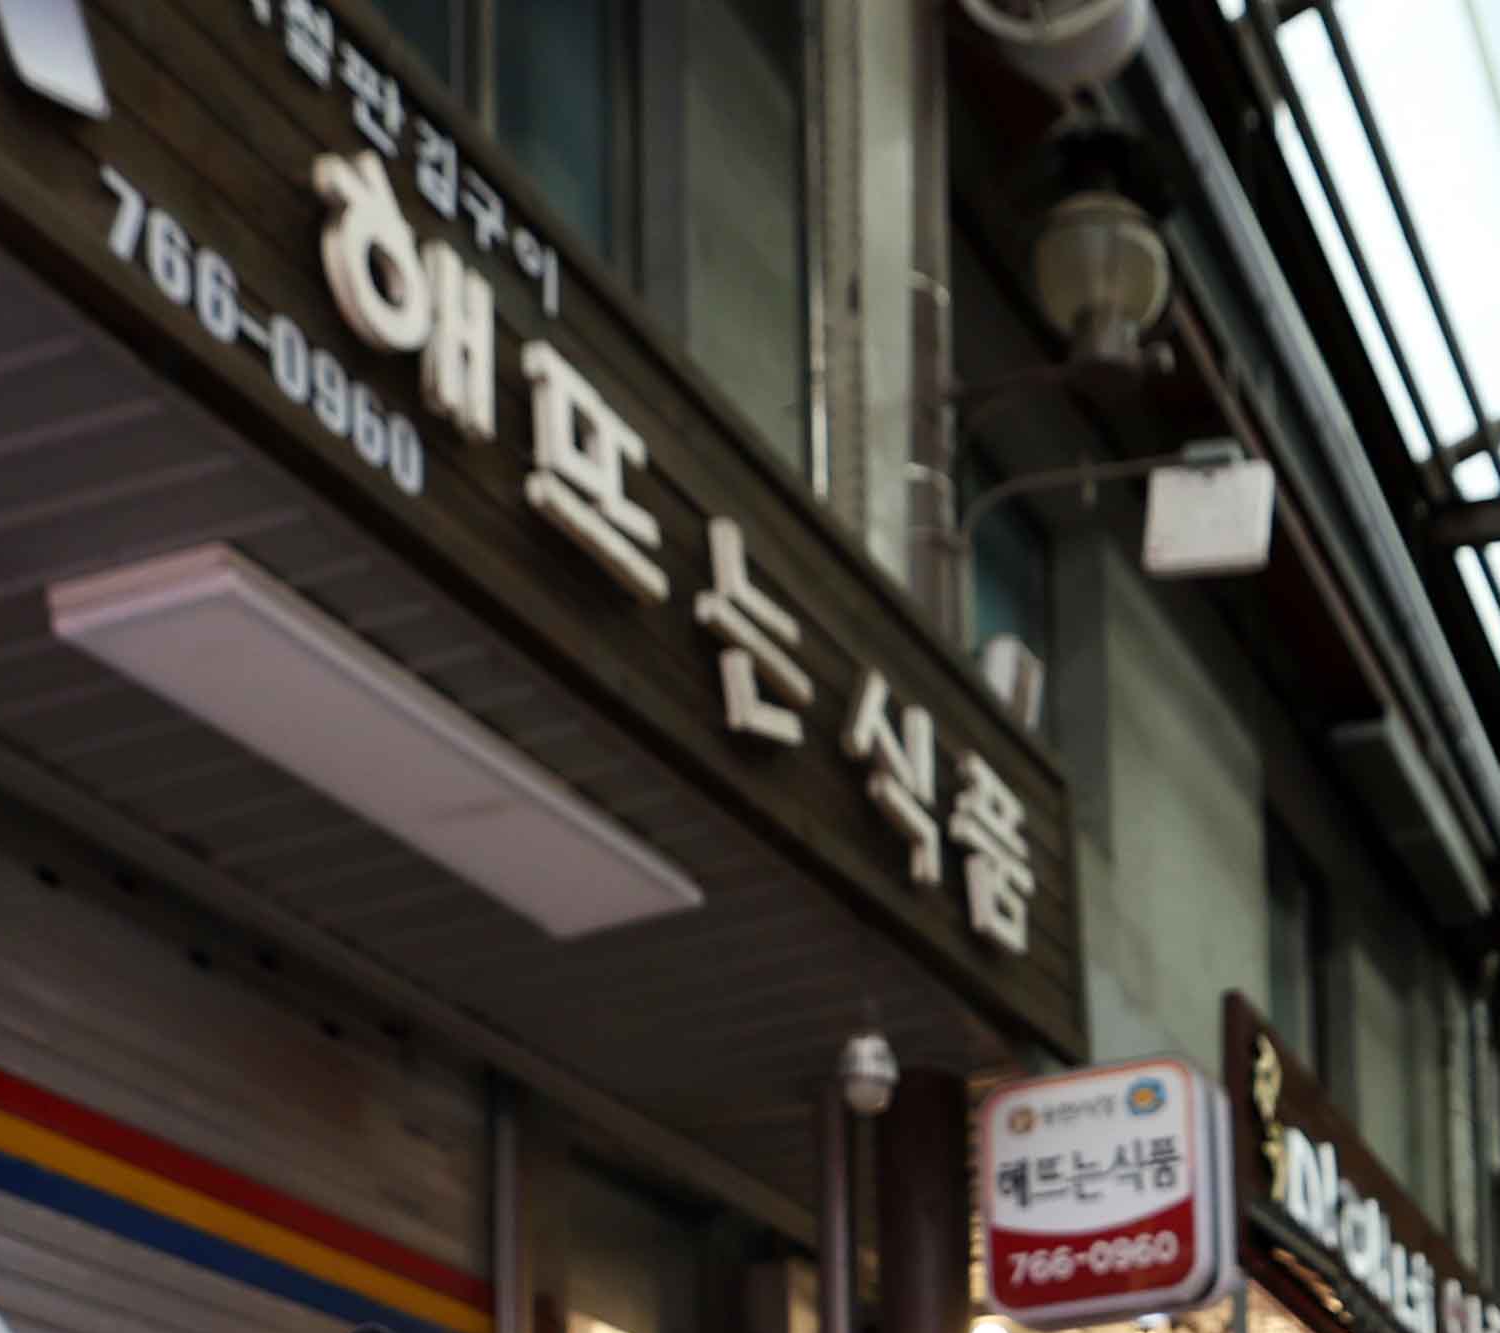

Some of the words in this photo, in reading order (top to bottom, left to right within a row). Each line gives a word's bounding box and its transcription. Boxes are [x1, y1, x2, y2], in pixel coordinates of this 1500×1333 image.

[101, 165, 425, 497] 766-0960
[312, 148, 1037, 955] 해뜨는식품
[997, 1136, 1182, 1208] 해뜨는식품
[1008, 1229, 1180, 1288] 766-0960
